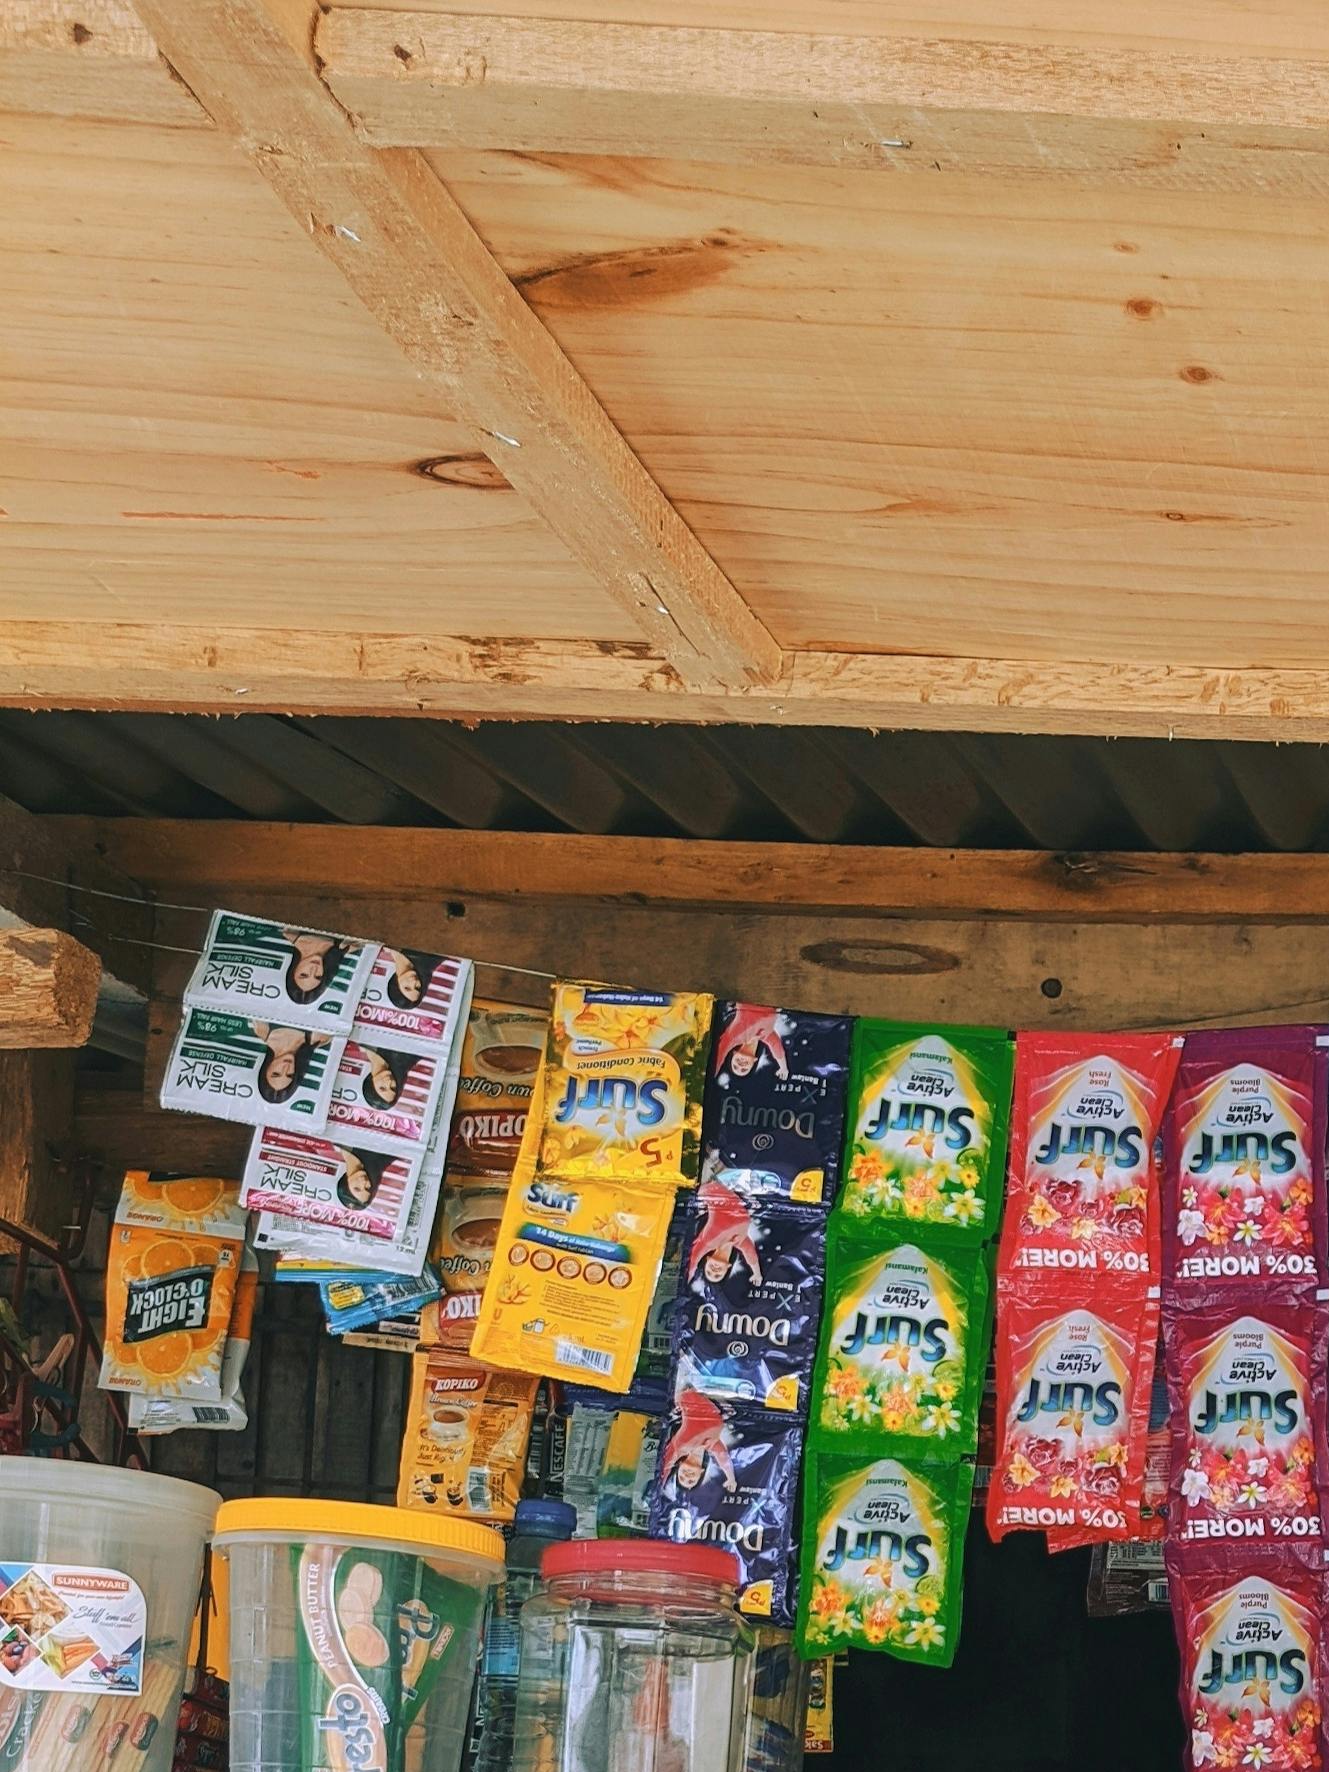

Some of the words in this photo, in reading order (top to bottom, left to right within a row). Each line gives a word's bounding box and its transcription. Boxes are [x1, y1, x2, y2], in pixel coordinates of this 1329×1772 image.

[207, 962, 254, 979] SILK
[201, 975, 281, 999] CREAM
[576, 1057, 635, 1070] Conditioner
[634, 1056, 666, 1069] Fabric
[909, 1051, 953, 1065] Kalamansi
[181, 1059, 227, 1077] SILK
[1088, 1070, 1112, 1079] Fresh
[175, 1073, 254, 1099] CREAM
[791, 1072, 819, 1086] Banlaw
[910, 1074, 945, 1086] Clean
[1089, 1078, 1110, 1087] Rose
[906, 1081, 956, 1099] Active
[1231, 1086, 1260, 1094] Purple
[554, 1074, 669, 1126] Surf
[1080, 1097, 1114, 1107] Clean
[1076, 1104, 1126, 1120] Active
[1229, 1104, 1262, 1113] Clean
[720, 1095, 815, 1140] Downy
[864, 1098, 975, 1150] Surf
[1226, 1110, 1275, 1127] Active
[459, 1114, 529, 1140] OPIKO
[1035, 1122, 1143, 1168] Surf
[1189, 1130, 1298, 1175] Surf
[263, 1164, 307, 1183] SILK
[259, 1176, 333, 1202] CREAM
[526, 1182, 580, 1214] Surf
[884, 1262, 929, 1275] Kalamansi
[1266, 1255, 1318, 1275] 30%
[765, 1279, 794, 1292] Banlaw
[886, 1284, 920, 1298] Clean
[131, 1278, 205, 1316] O'CLOCK
[882, 1292, 930, 1310] Active
[137, 1296, 206, 1334] EIGHT
[695, 1302, 791, 1347] Downy
[1067, 1324, 1091, 1334] Fresh
[840, 1312, 950, 1363] Surf
[1068, 1333, 1088, 1341] Rose
[1232, 1333, 1264, 1341] Blooms
[1234, 1341, 1262, 1350] Purple
[1060, 1352, 1093, 1363] Clean
[1231, 1360, 1265, 1370] Clean
[1055, 1360, 1102, 1375] Active
[1229, 1367, 1278, 1384] Active
[434, 1377, 479, 1392] KOPIKO
[1017, 1377, 1122, 1427] Surf
[1193, 1388, 1298, 1435] Surf
[865, 1478, 908, 1489] Kalamansi
[867, 1501, 900, 1511] Clean
[863, 1508, 911, 1523] Active
[667, 1507, 764, 1552] Downy
[1270, 1516, 1321, 1536] 30%
[823, 1525, 932, 1578] Surf
[55, 1575, 129, 1591] SUNNYWARE
[306, 1562, 321, 1615] BUTTER
[1238, 1592, 1270, 1600] Blooms
[1240, 1600, 1268, 1609] Purple
[1238, 1621, 1270, 1631] Clean
[310, 1615, 335, 1670] PEANUT
[1235, 1629, 1283, 1643] Active
[1198, 1648, 1306, 1695] Surf
